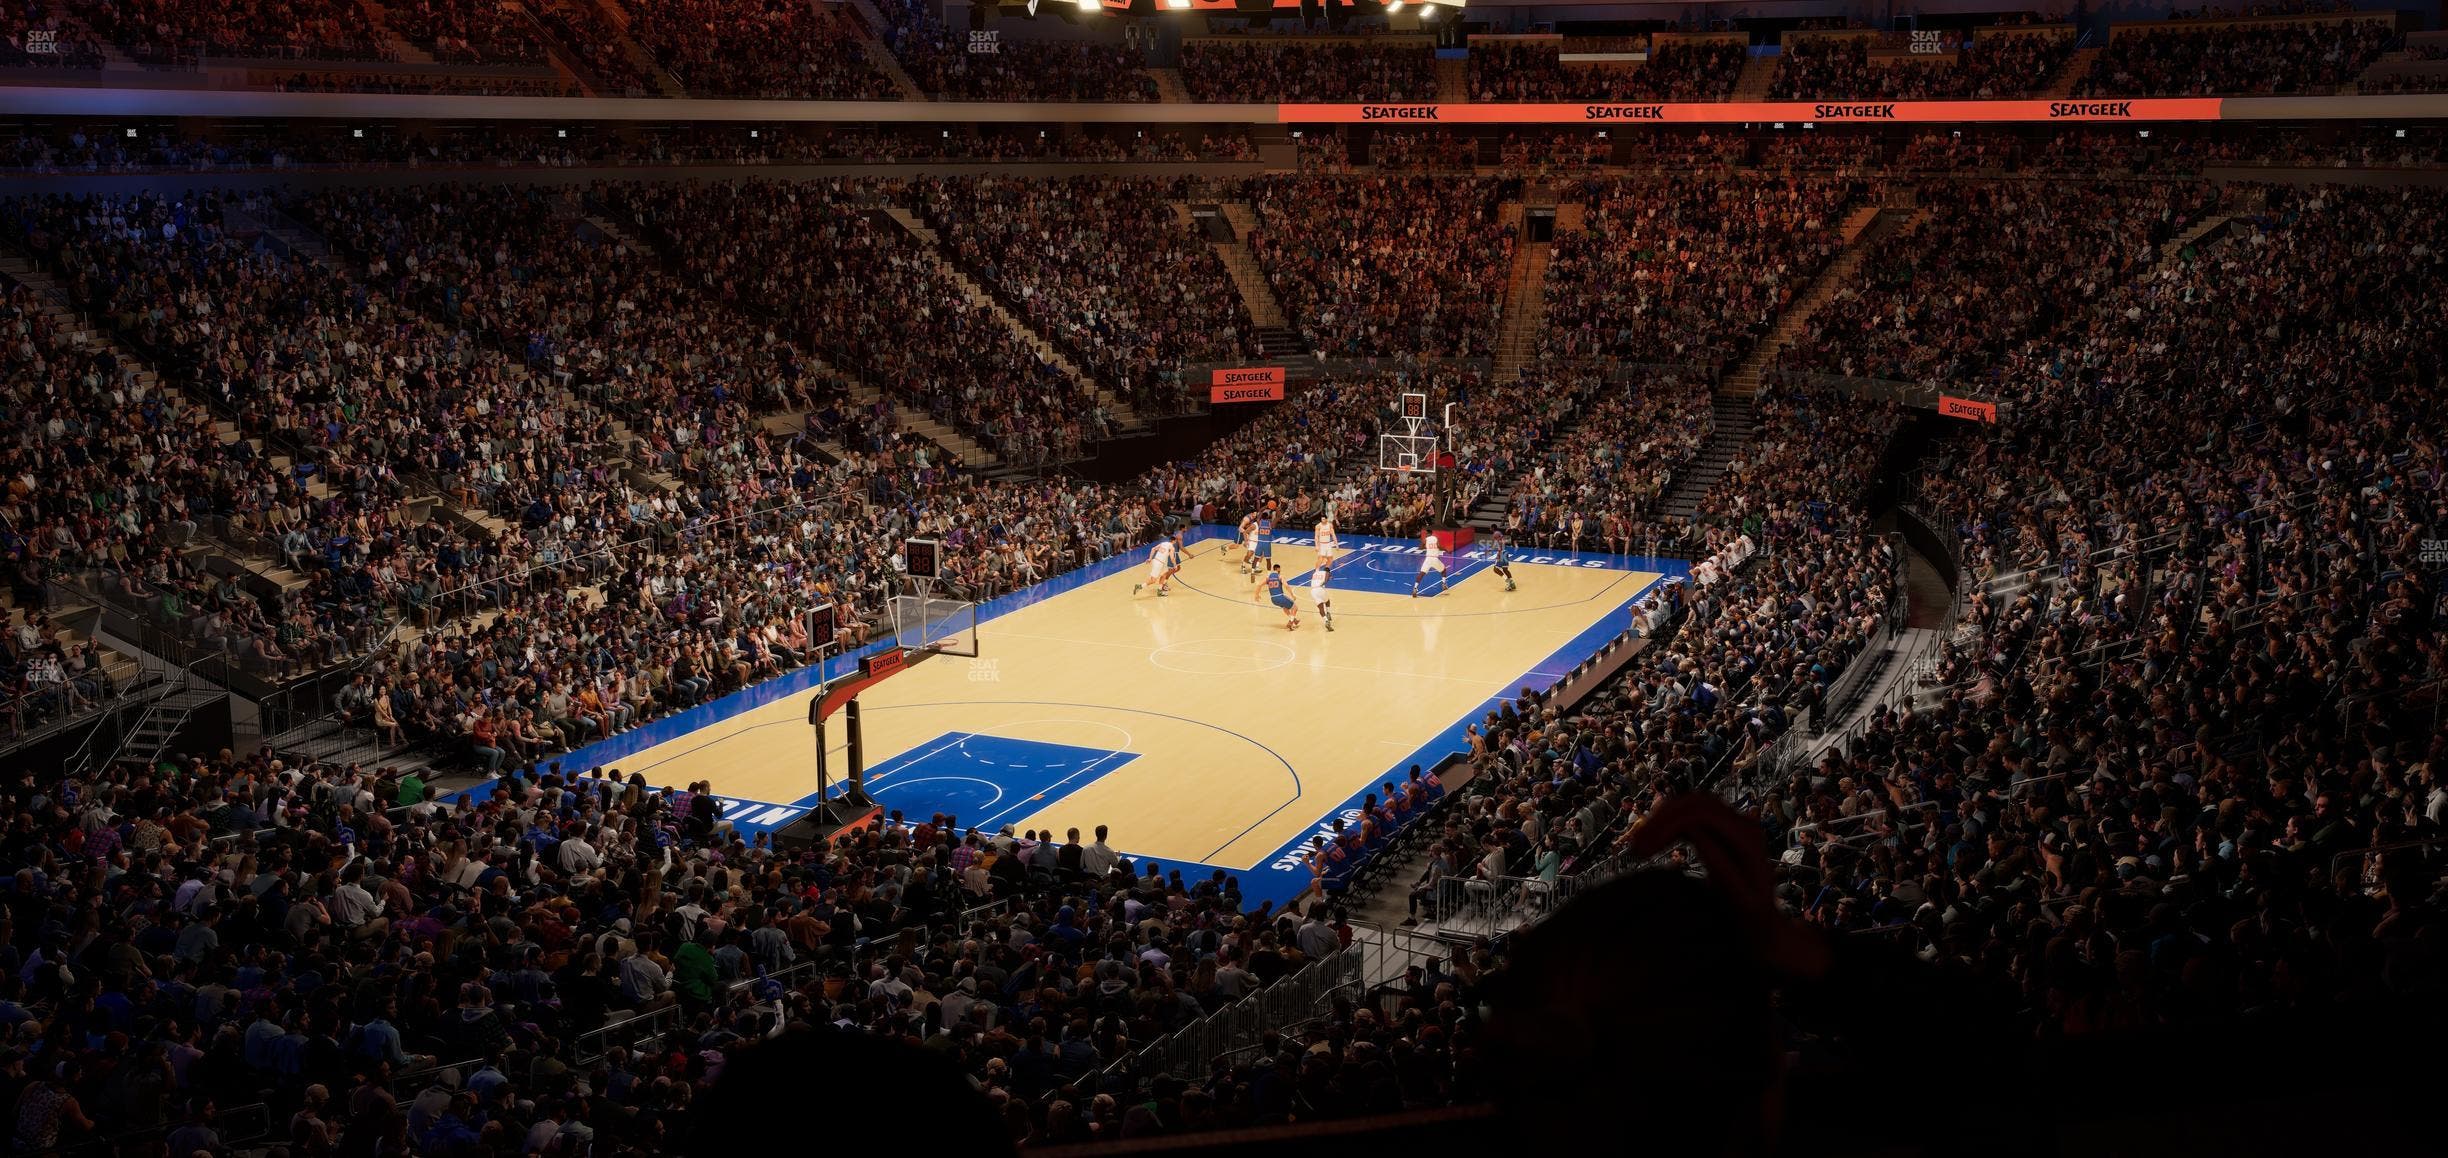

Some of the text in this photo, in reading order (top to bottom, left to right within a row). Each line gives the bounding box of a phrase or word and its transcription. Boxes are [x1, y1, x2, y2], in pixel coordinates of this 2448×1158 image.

[1362, 106, 1438, 119] SEATGEEK
[1586, 105, 1664, 119] SEATGEEK
[1814, 104, 1895, 118] SEATGEEK
[2050, 101, 2132, 117] SEATGEEK
[1225, 371, 1273, 383] SEATGEEK
[1223, 388, 1272, 400] SEATGEEK
[1949, 402, 1987, 418] SEATGEEK
[873, 653, 900, 672] SEATGEEK
